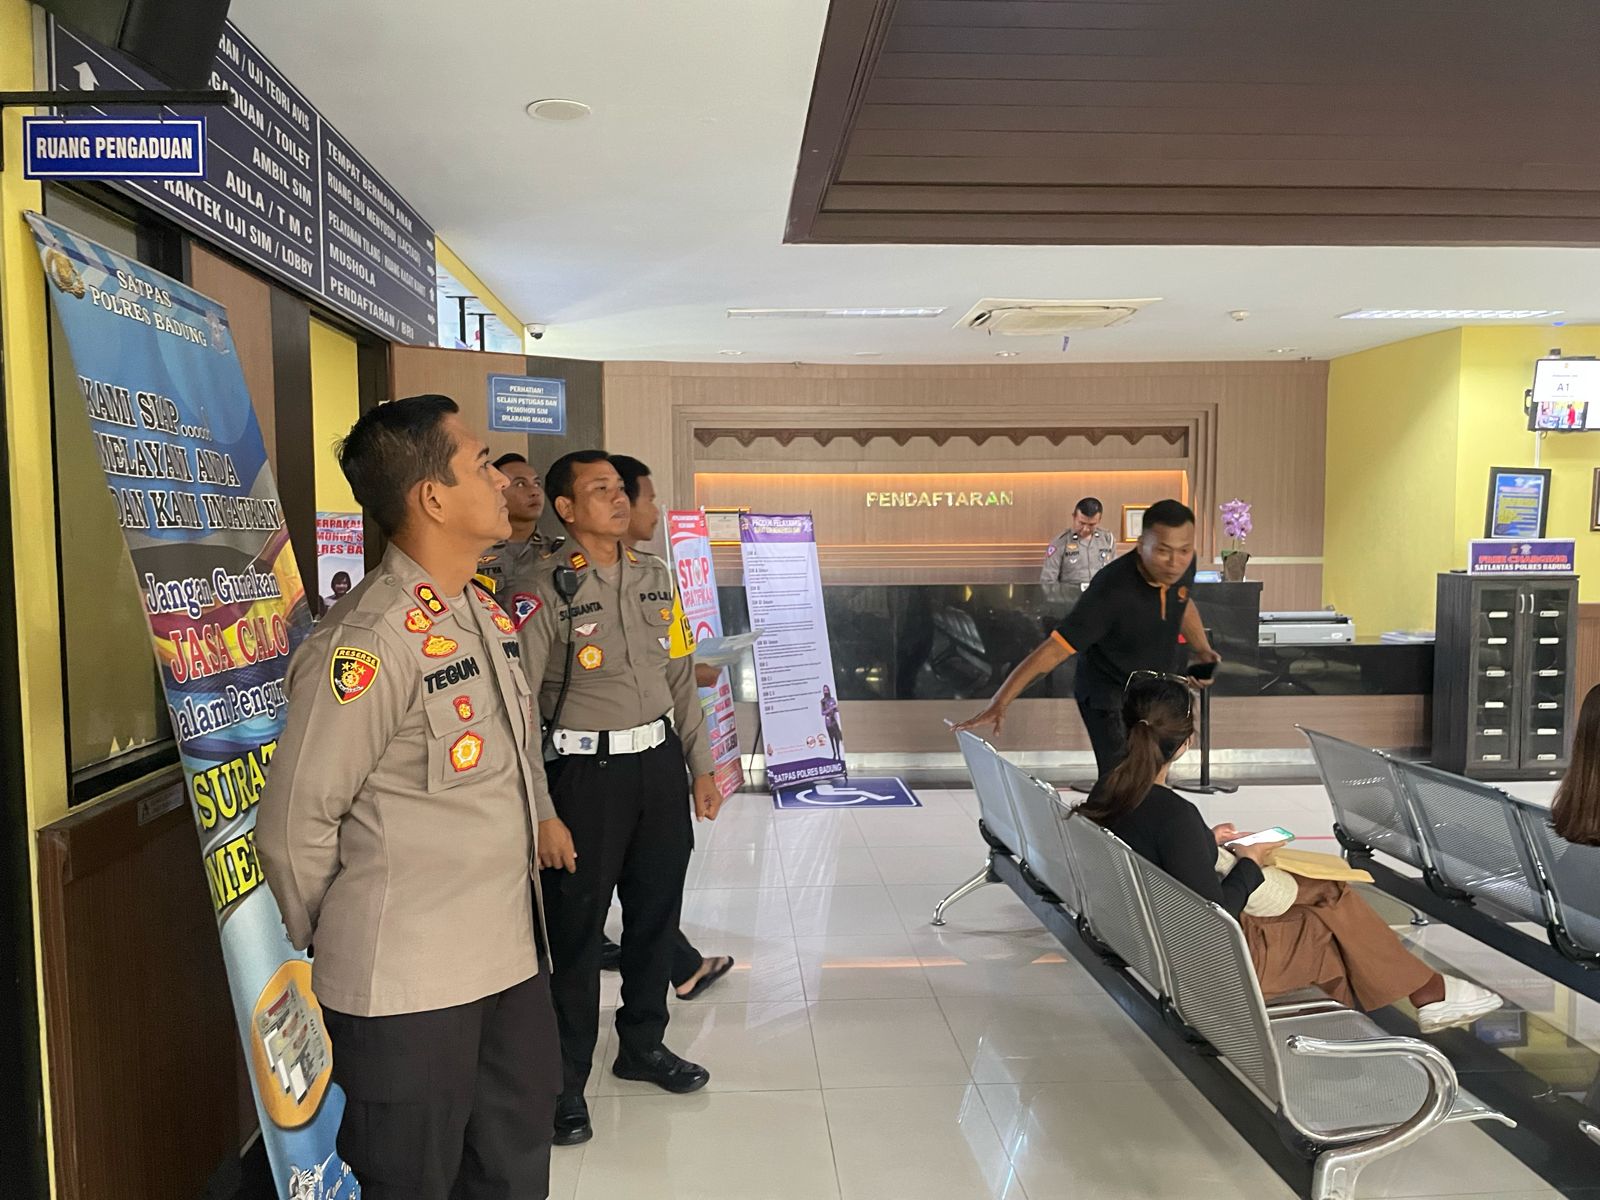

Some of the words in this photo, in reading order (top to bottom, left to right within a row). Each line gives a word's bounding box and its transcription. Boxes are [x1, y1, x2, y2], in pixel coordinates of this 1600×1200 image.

[247, 58, 263, 88] UJI
[265, 75, 290, 114] TEORI
[292, 103, 310, 132] AVIS
[36, 136, 91, 160] RUANG
[95, 136, 194, 161] PENGADUAN
[274, 125, 311, 170] TOILET
[326, 139, 361, 183] TEMPAT
[252, 146, 290, 190] AMBIL
[292, 177, 312, 207] SIM
[327, 171, 353, 205] RUANG
[225, 170, 265, 212] AULA
[276, 205, 286, 226] T
[289, 214, 301, 237] M
[304, 226, 313, 245] C
[153, 180, 222, 224] RAKTEK
[225, 208, 247, 238] UJI
[249, 225, 273, 254] SIM
[281, 245, 314, 278] LOBBY
[329, 242, 376, 288] MUSHOLA
[116, 269, 173, 309] SATPAS
[330, 275, 396, 329] PENDAFTARAN
[89, 285, 152, 326] POLRES
[154, 314, 208, 348] BADUNG
[78, 375, 138, 428] KAMI
[501, 414, 531, 423] DILARANG
[531, 416, 553, 424] MASUK
[517, 397, 545, 406] PETUGAS
[196, 447, 242, 487] ANDA
[148, 490, 204, 530] KAMI
[201, 494, 281, 531] INGATKAN
[866, 490, 1014, 508] PENDAFTARAN
[1474, 563, 1514, 571] SATLANTAS
[1514, 563, 1542, 571] POLRES
[1542, 562, 1572, 570] BADUNG
[145, 572, 214, 620] Jangan
[212, 565, 282, 605] Gunakan
[168, 622, 236, 684] JASA
[236, 612, 290, 665] CALO
[338, 650, 377, 666] RESERSE
[423, 656, 480, 695] TEGUH
[773, 770, 797, 783] SATPAS
[796, 767, 819, 779] POLRES
[818, 763, 842, 775] BADUNG
